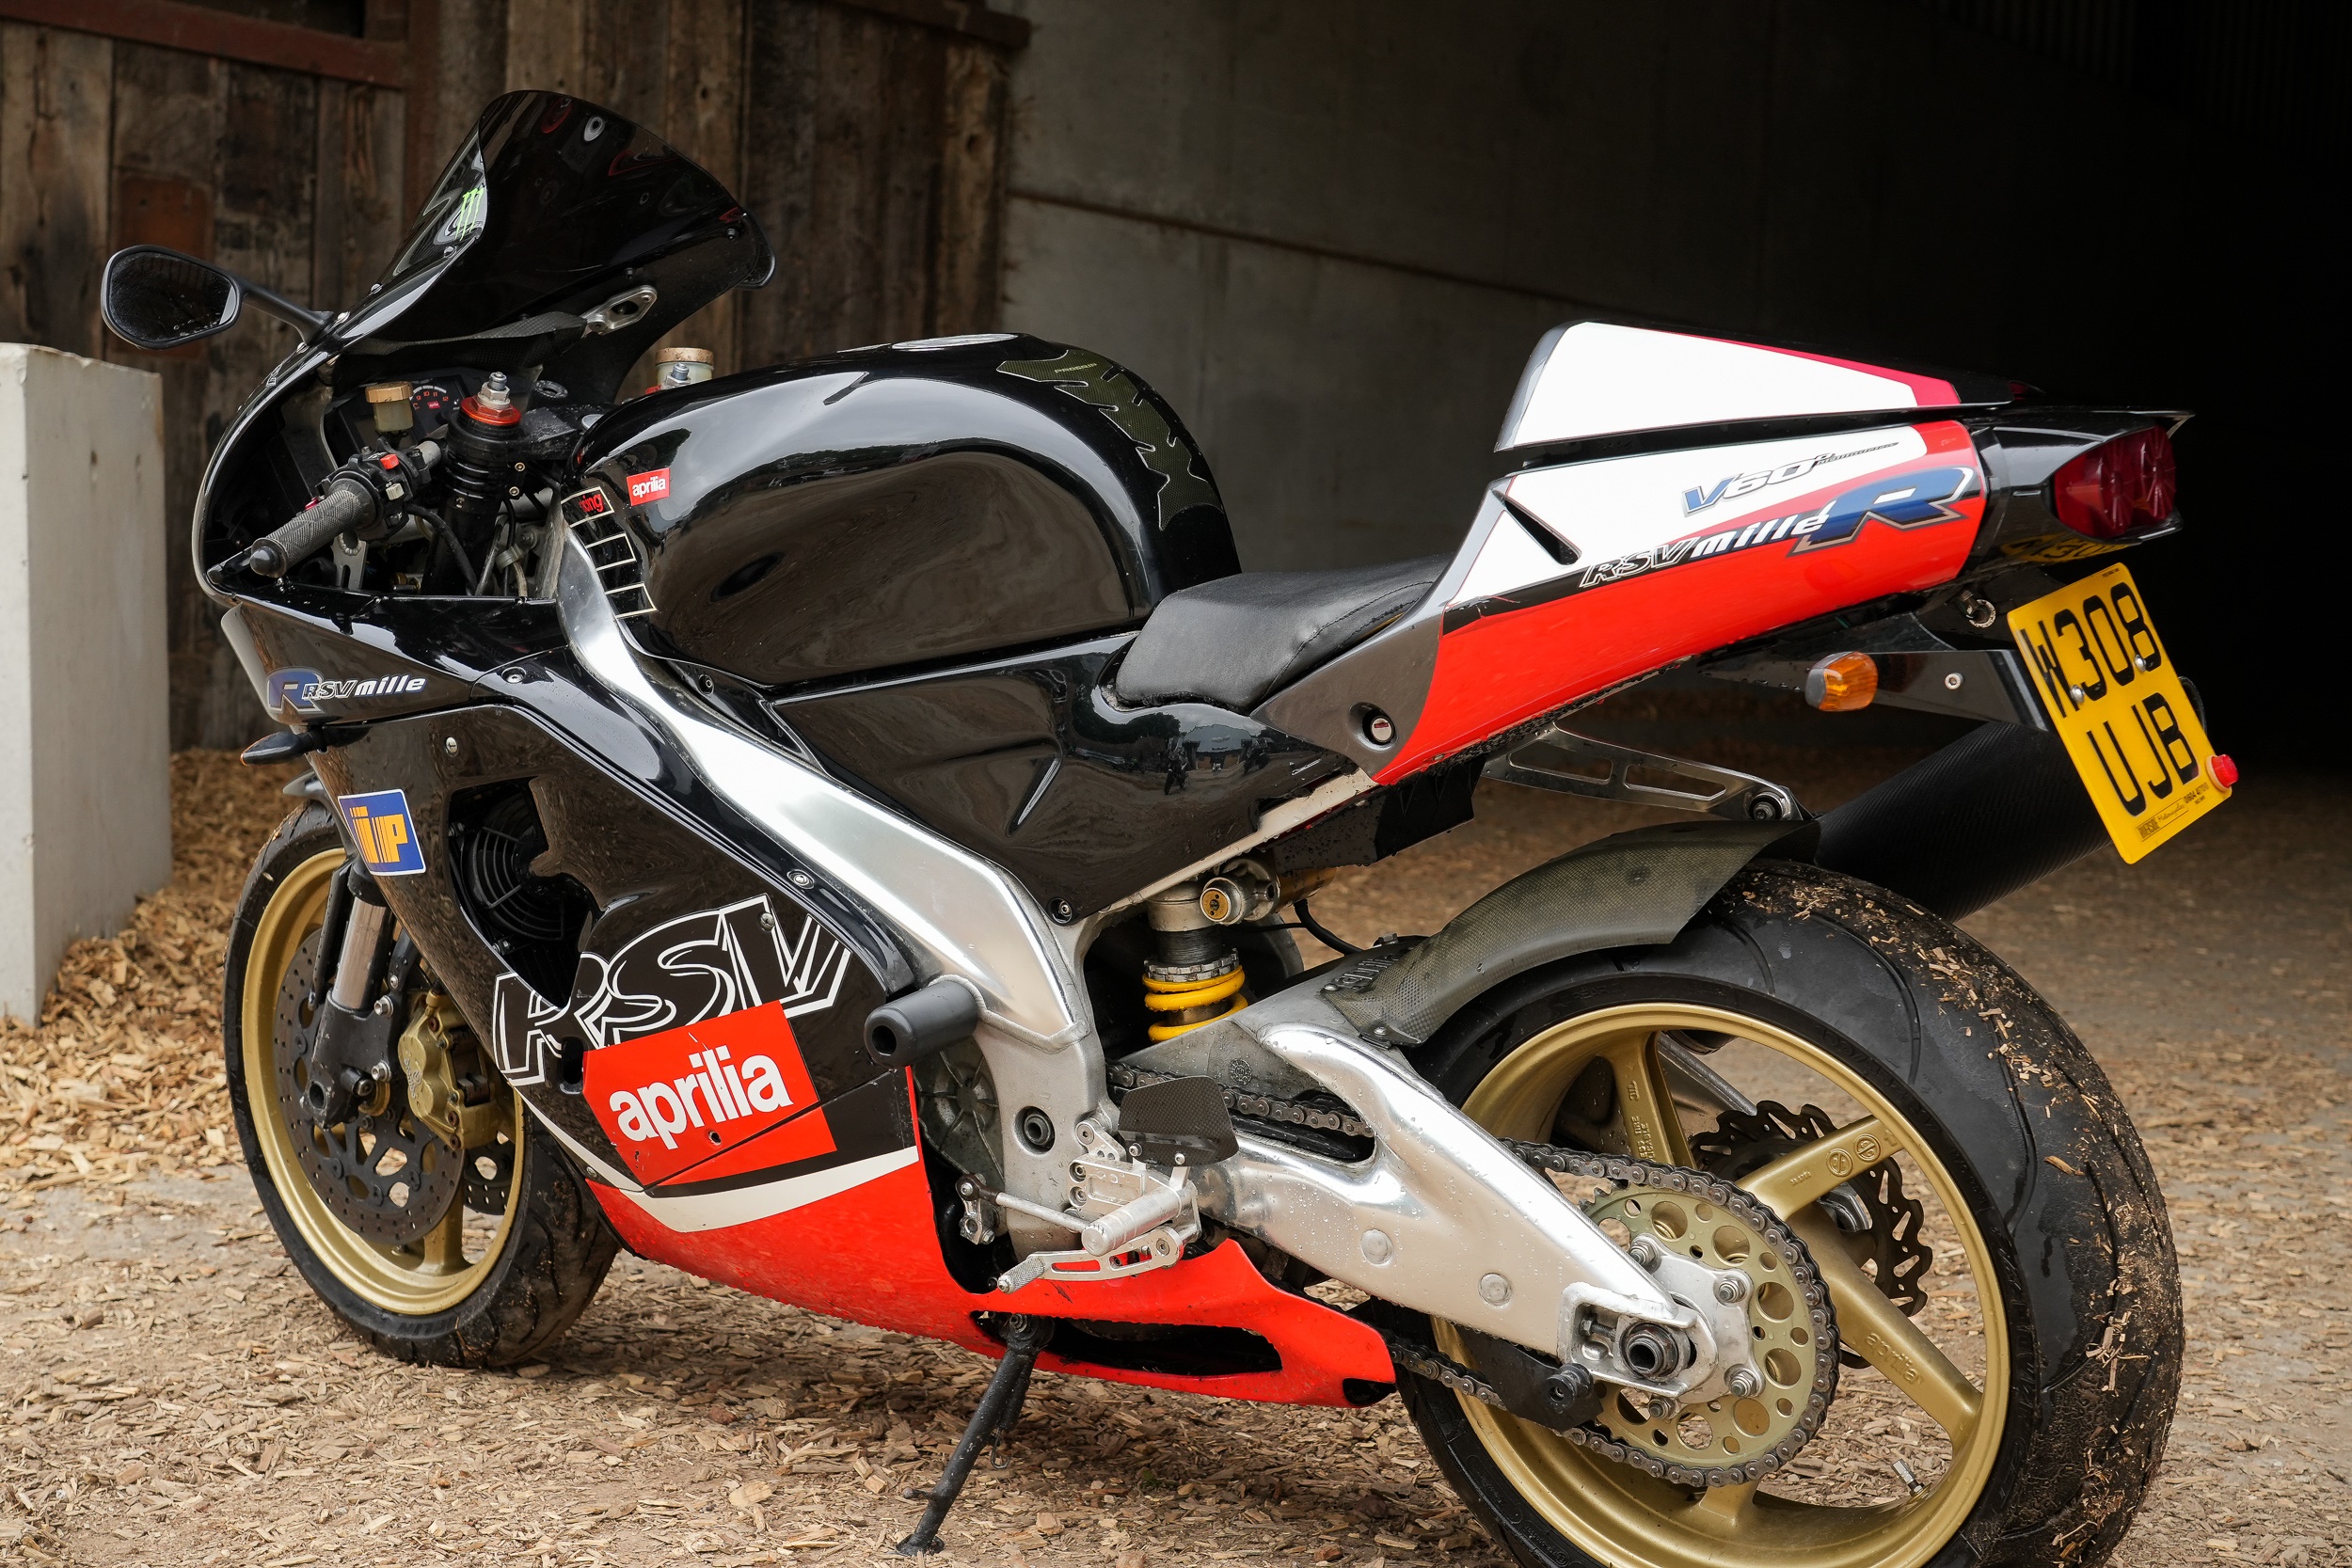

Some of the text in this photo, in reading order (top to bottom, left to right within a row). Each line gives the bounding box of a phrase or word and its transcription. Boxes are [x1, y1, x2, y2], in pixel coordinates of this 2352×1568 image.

[632, 476, 666, 498] aprilia
[354, 673, 426, 697] mille
[2020, 581, 2162, 719] W308
[2086, 691, 2200, 817] UJB
[608, 1044, 795, 1150] aprilia
